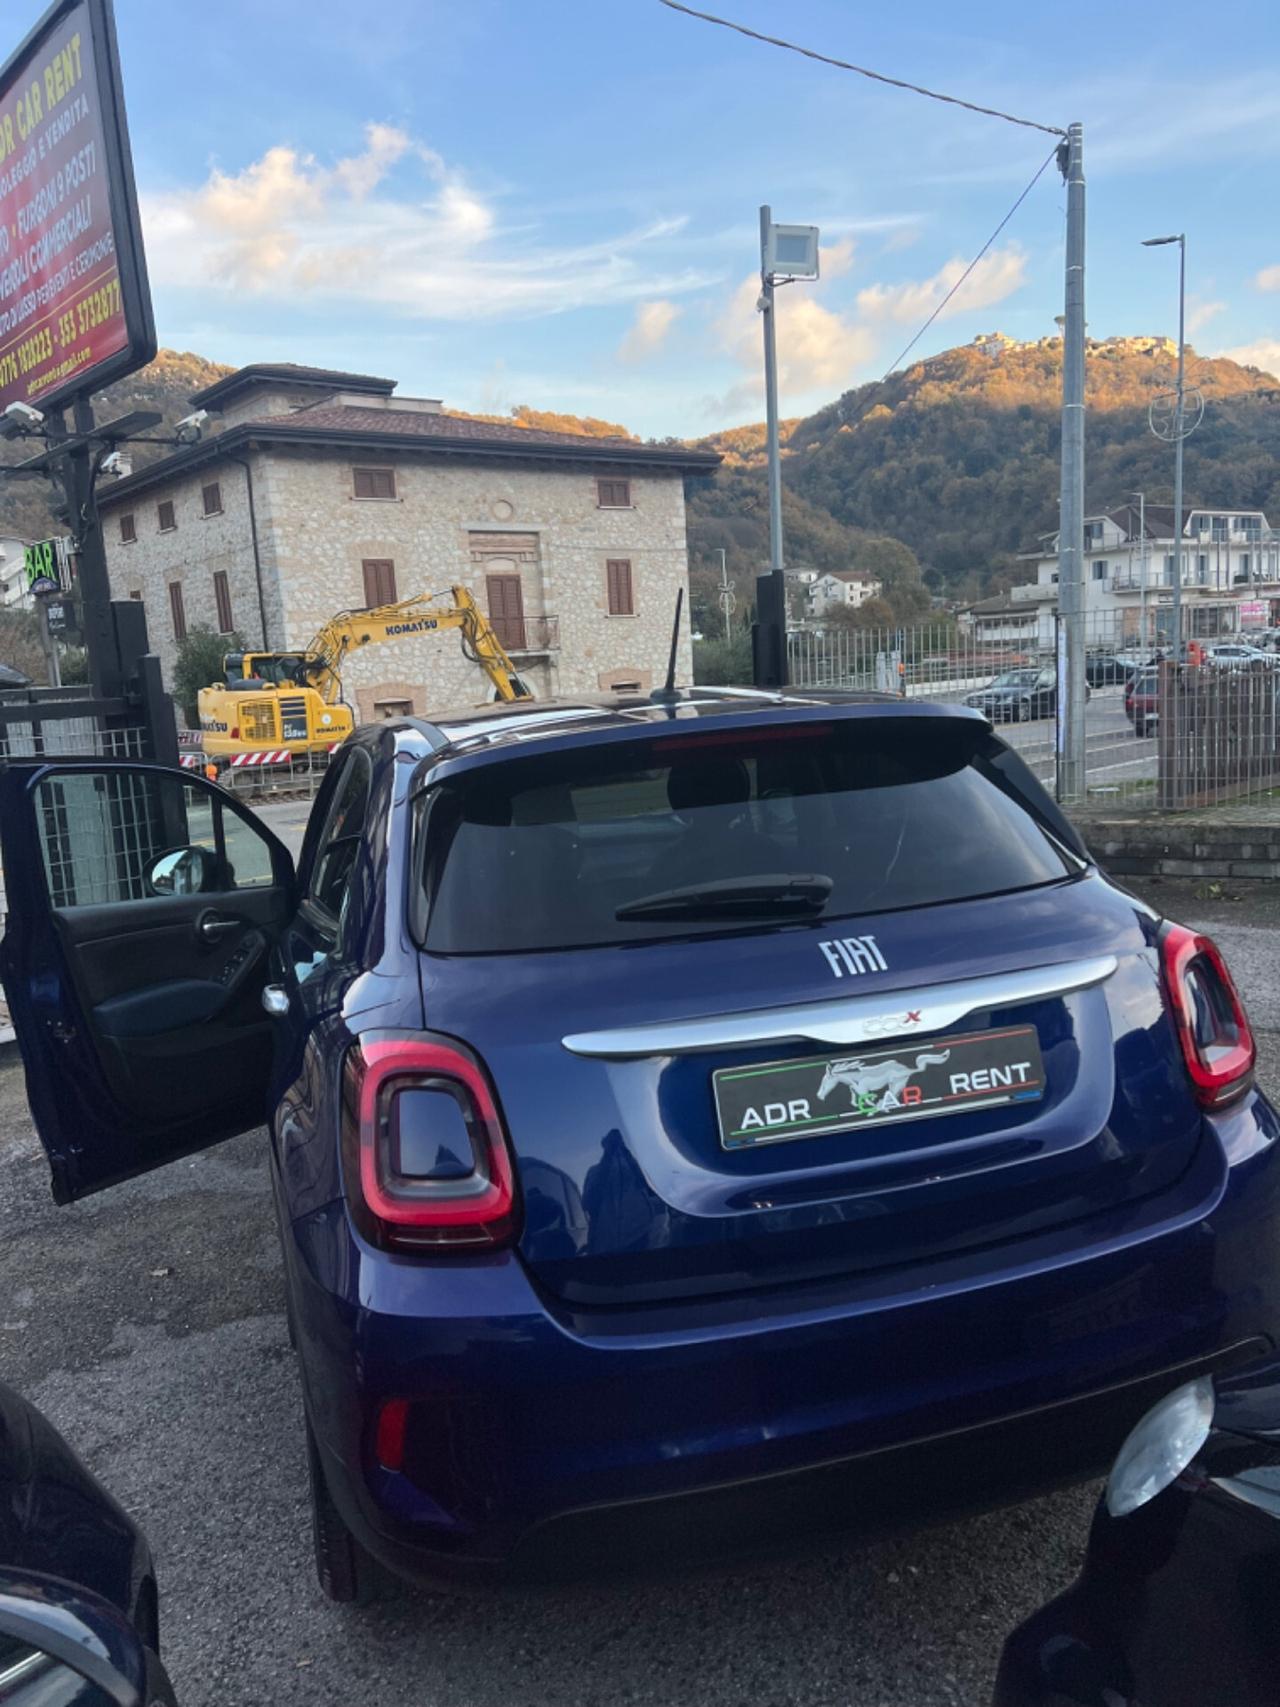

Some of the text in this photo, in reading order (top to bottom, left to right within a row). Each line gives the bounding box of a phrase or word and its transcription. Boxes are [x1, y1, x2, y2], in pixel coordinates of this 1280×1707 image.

[16, 81, 43, 142] CAR
[44, 32, 82, 111] RENT
[0, 92, 89, 200] OLEGGIO E VENDITA
[17, 176, 57, 240] FURGONI
[57, 170, 64, 202] 9
[65, 139, 96, 196] POSTI
[24, 541, 57, 588] BAR
[385, 618, 438, 636] KOMATSU
[818, 935, 888, 978] FIAT
[741, 1062, 1031, 1130] ADR CAR RENT
